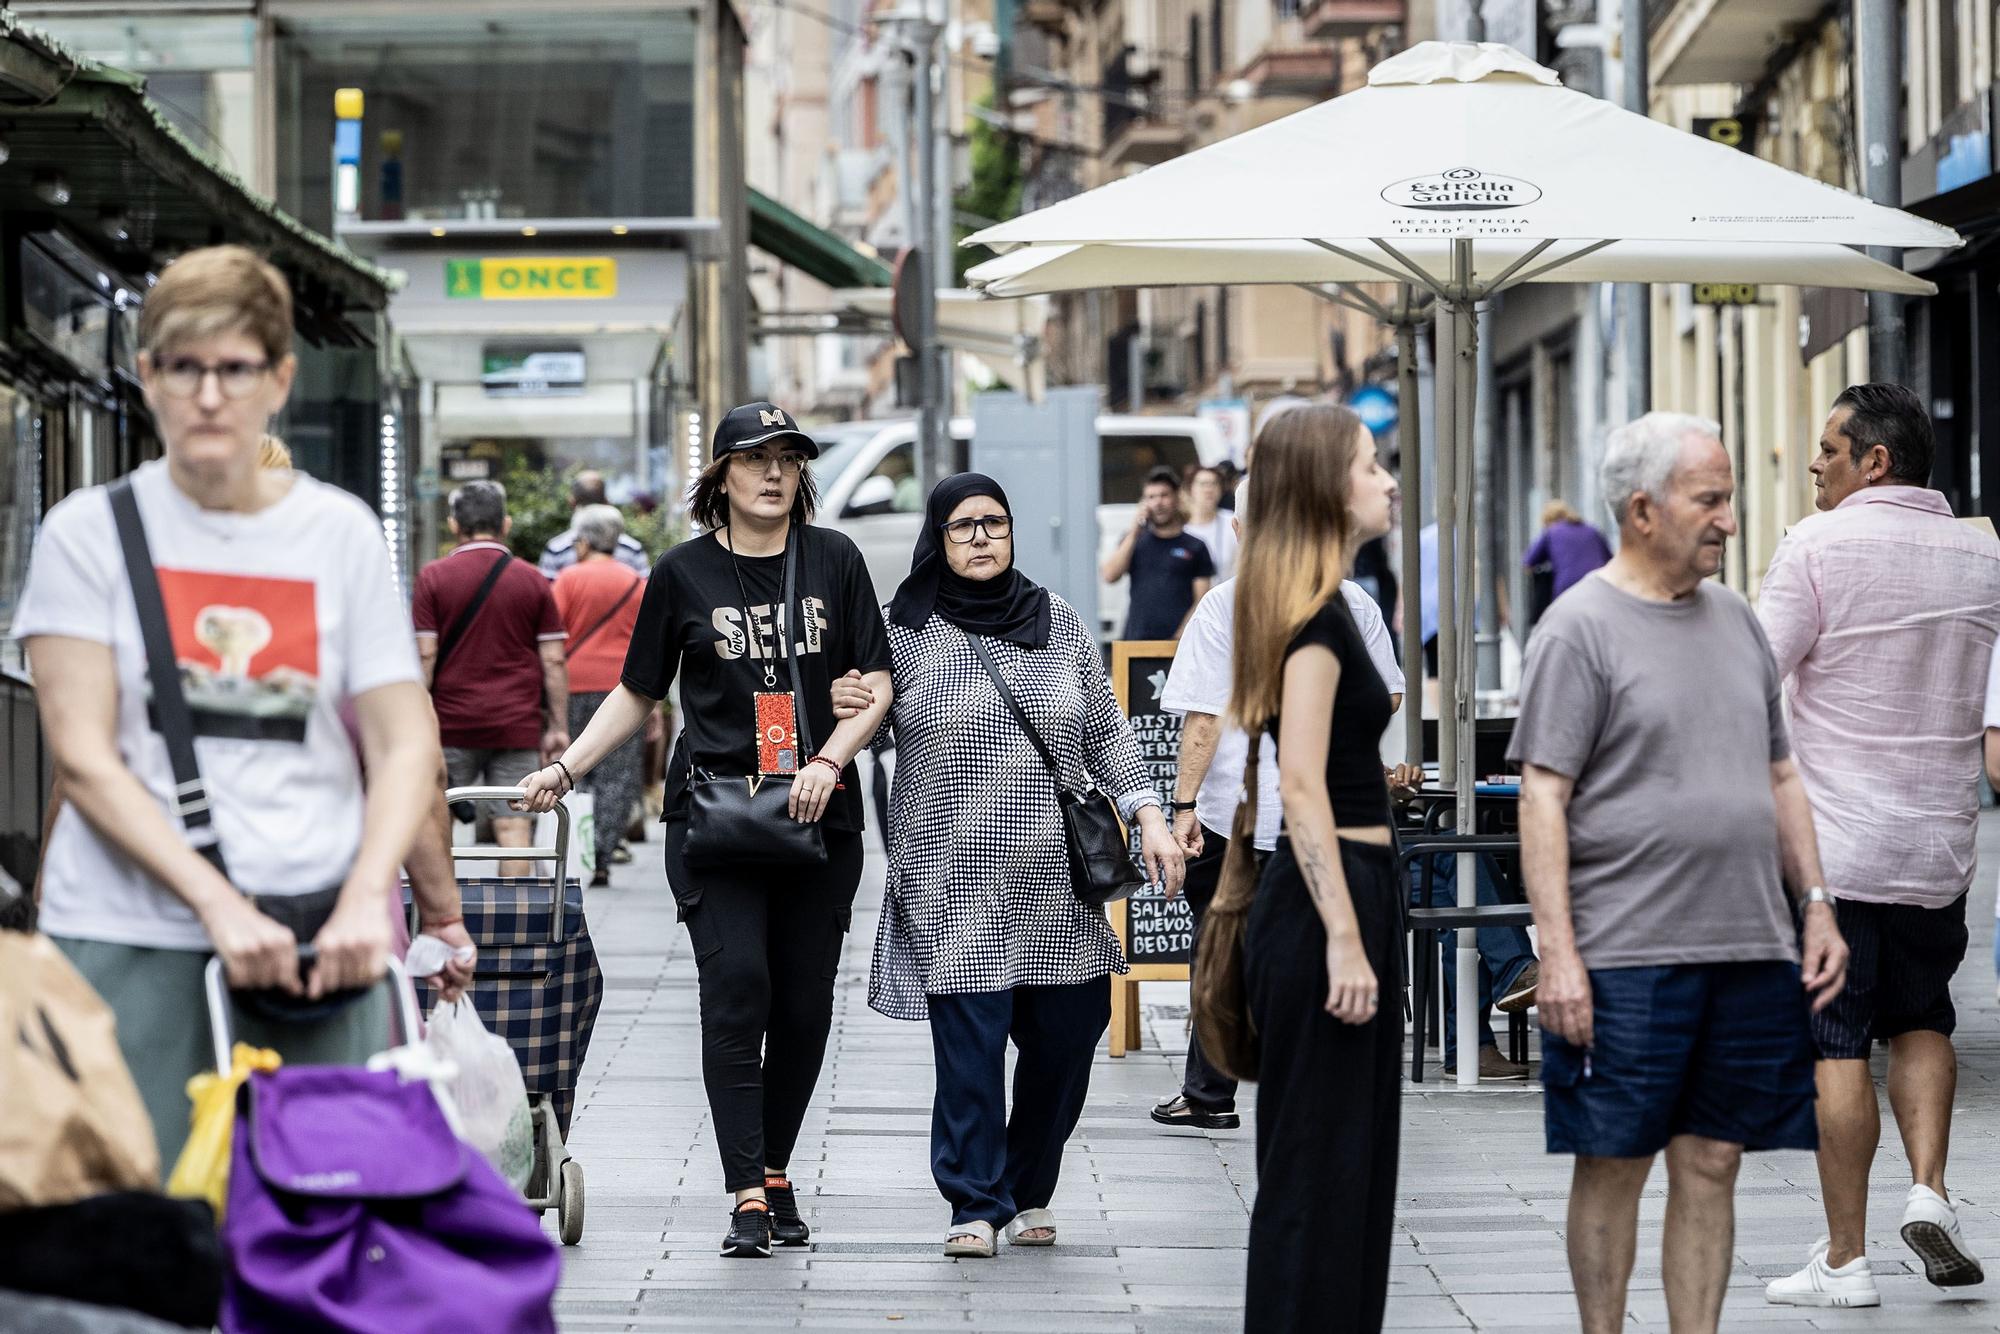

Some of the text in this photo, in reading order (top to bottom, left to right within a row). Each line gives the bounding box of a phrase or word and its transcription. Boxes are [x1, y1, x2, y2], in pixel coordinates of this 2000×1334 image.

[1409, 182, 1514, 193] Estrella
[1412, 191, 1509, 203] Galicia
[1392, 217, 1530, 225] RESISTENCIA
[497, 266, 601, 290] ONCE
[759, 409, 786, 427] M
[711, 596, 828, 660] SELF
[804, 596, 819, 647] confidence
[728, 629, 744, 656] love
[745, 775, 765, 798] V
[1131, 901, 1193, 918] SALMO
[1133, 916, 1193, 935] HUEVOS
[1133, 933, 1192, 954] BEBID
